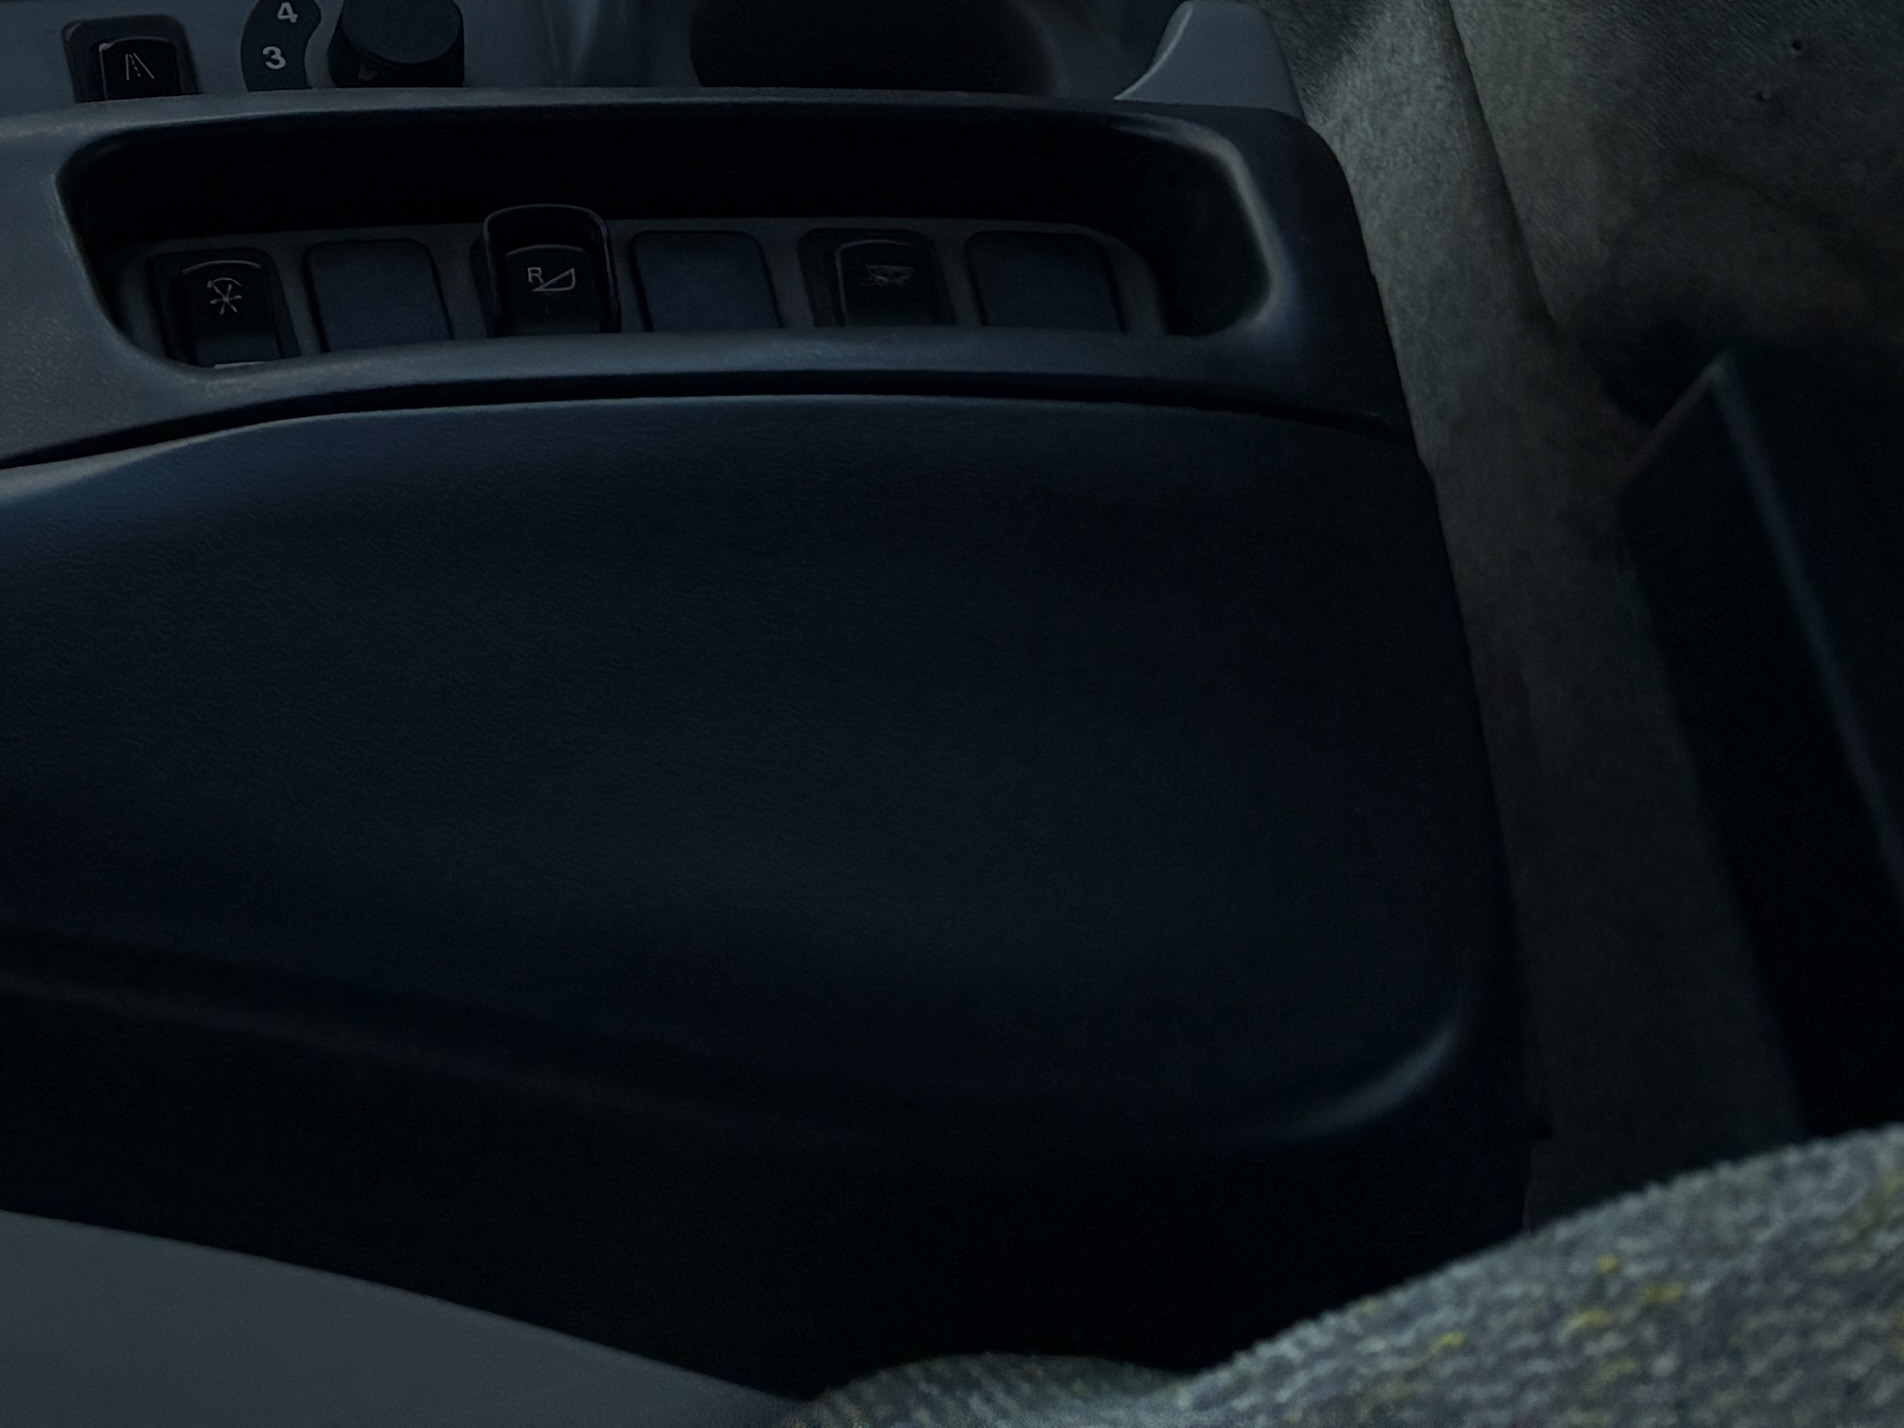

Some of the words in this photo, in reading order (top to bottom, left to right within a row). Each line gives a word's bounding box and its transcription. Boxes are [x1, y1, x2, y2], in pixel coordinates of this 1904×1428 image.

[277, 1, 299, 24] 4
[262, 45, 287, 70] 3
[527, 266, 545, 284] R
